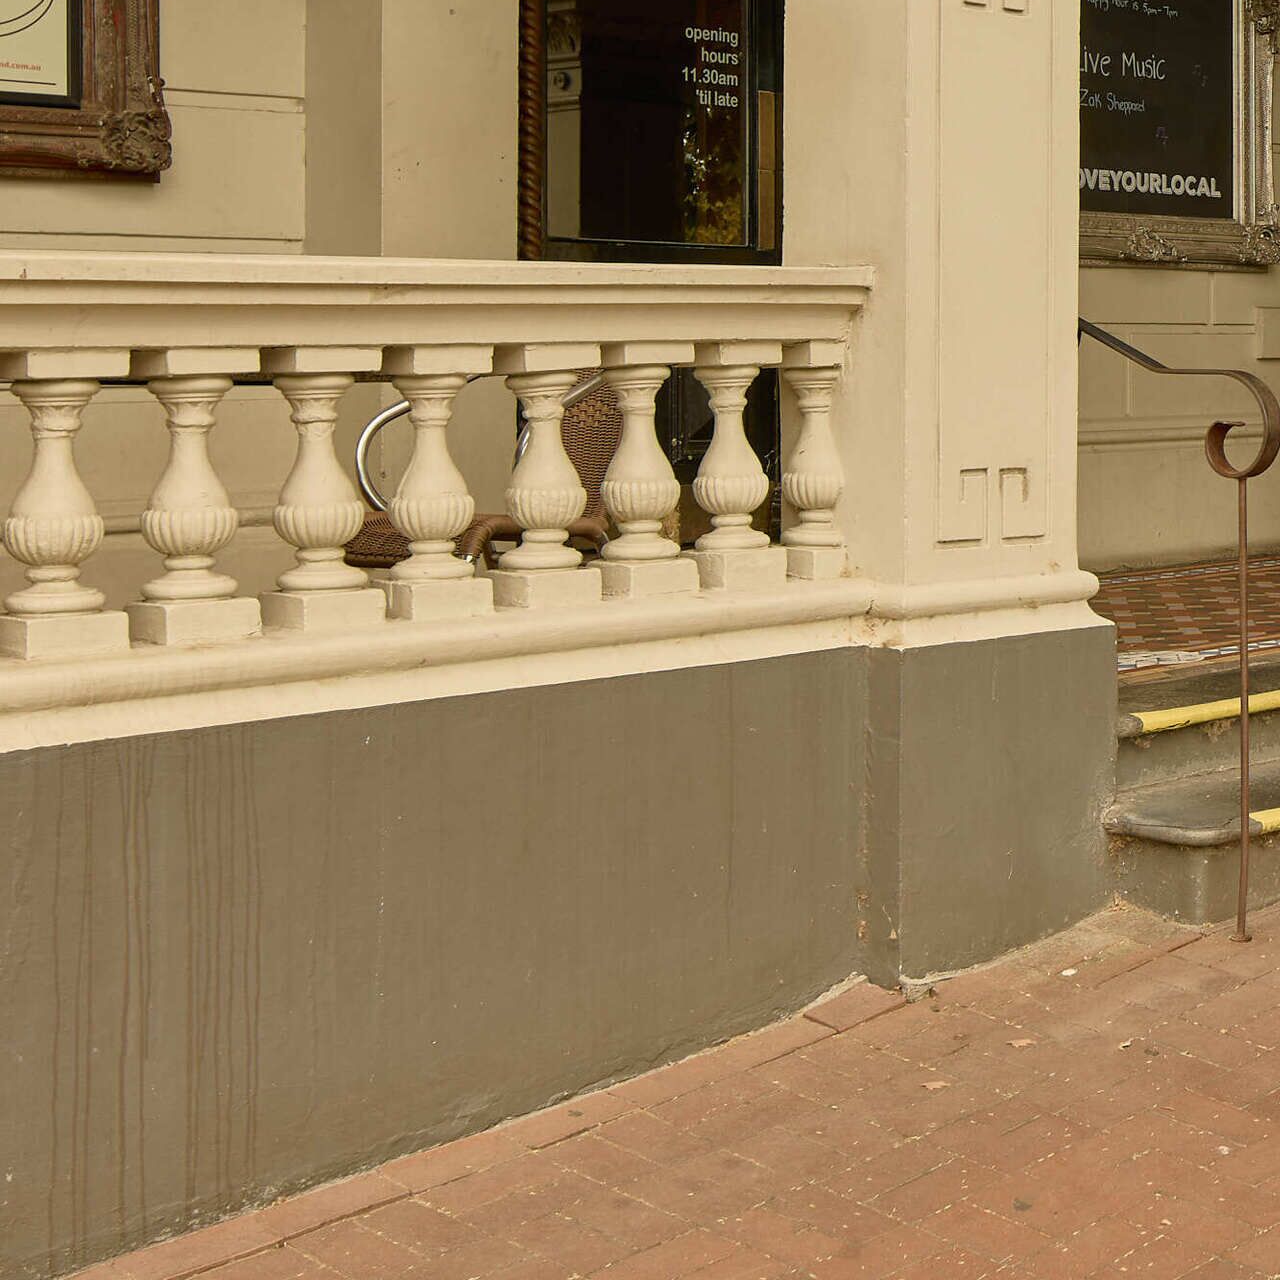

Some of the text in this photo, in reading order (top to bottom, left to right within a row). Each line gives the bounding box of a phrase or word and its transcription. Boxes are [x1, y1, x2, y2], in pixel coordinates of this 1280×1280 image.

[685, 27, 739, 47] opening
[701, 46, 739, 65] hours
[1121, 51, 1166, 80] Music
[681, 66, 739, 87] 11.30am
[714, 90, 739, 108] late
